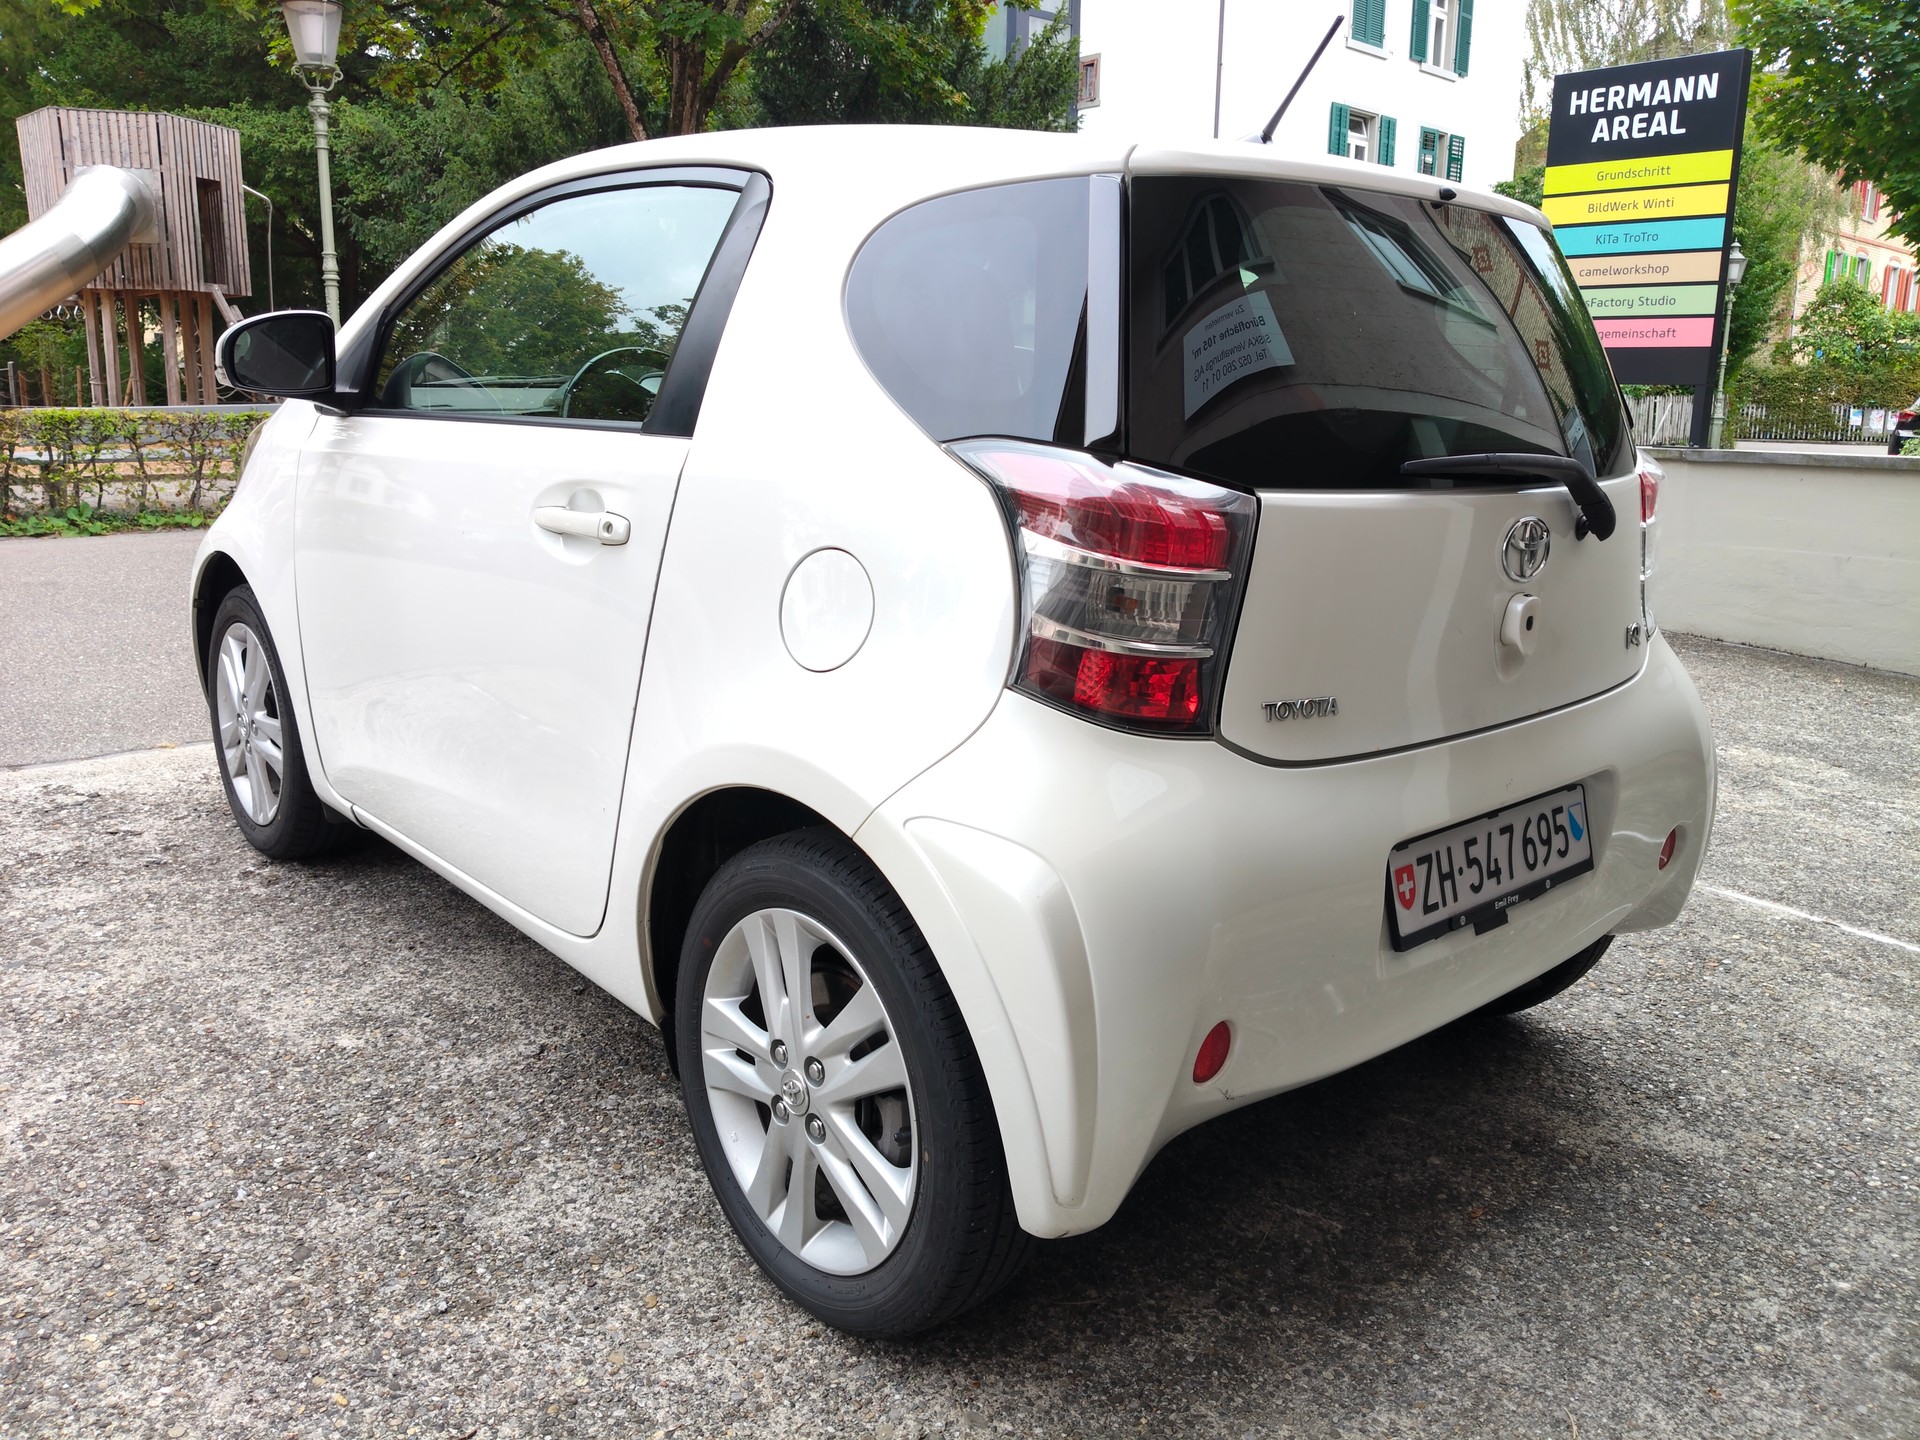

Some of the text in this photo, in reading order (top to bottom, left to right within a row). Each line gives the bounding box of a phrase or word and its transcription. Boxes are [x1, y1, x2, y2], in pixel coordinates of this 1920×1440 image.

[1569, 72, 1720, 116] HERMANN
[1590, 109, 1687, 143] AREAL
[1596, 165, 1672, 182] Grundschritt
[1587, 197, 1675, 214] BildWerk Winti
[1595, 232, 1660, 245] KiTa TroTro
[1578, 263, 1670, 278] camelworkshop
[1585, 295, 1677, 309] sFactory Studio
[1598, 328, 1677, 341] gemeinschaft
[1261, 696, 1339, 723] TOYOTA
